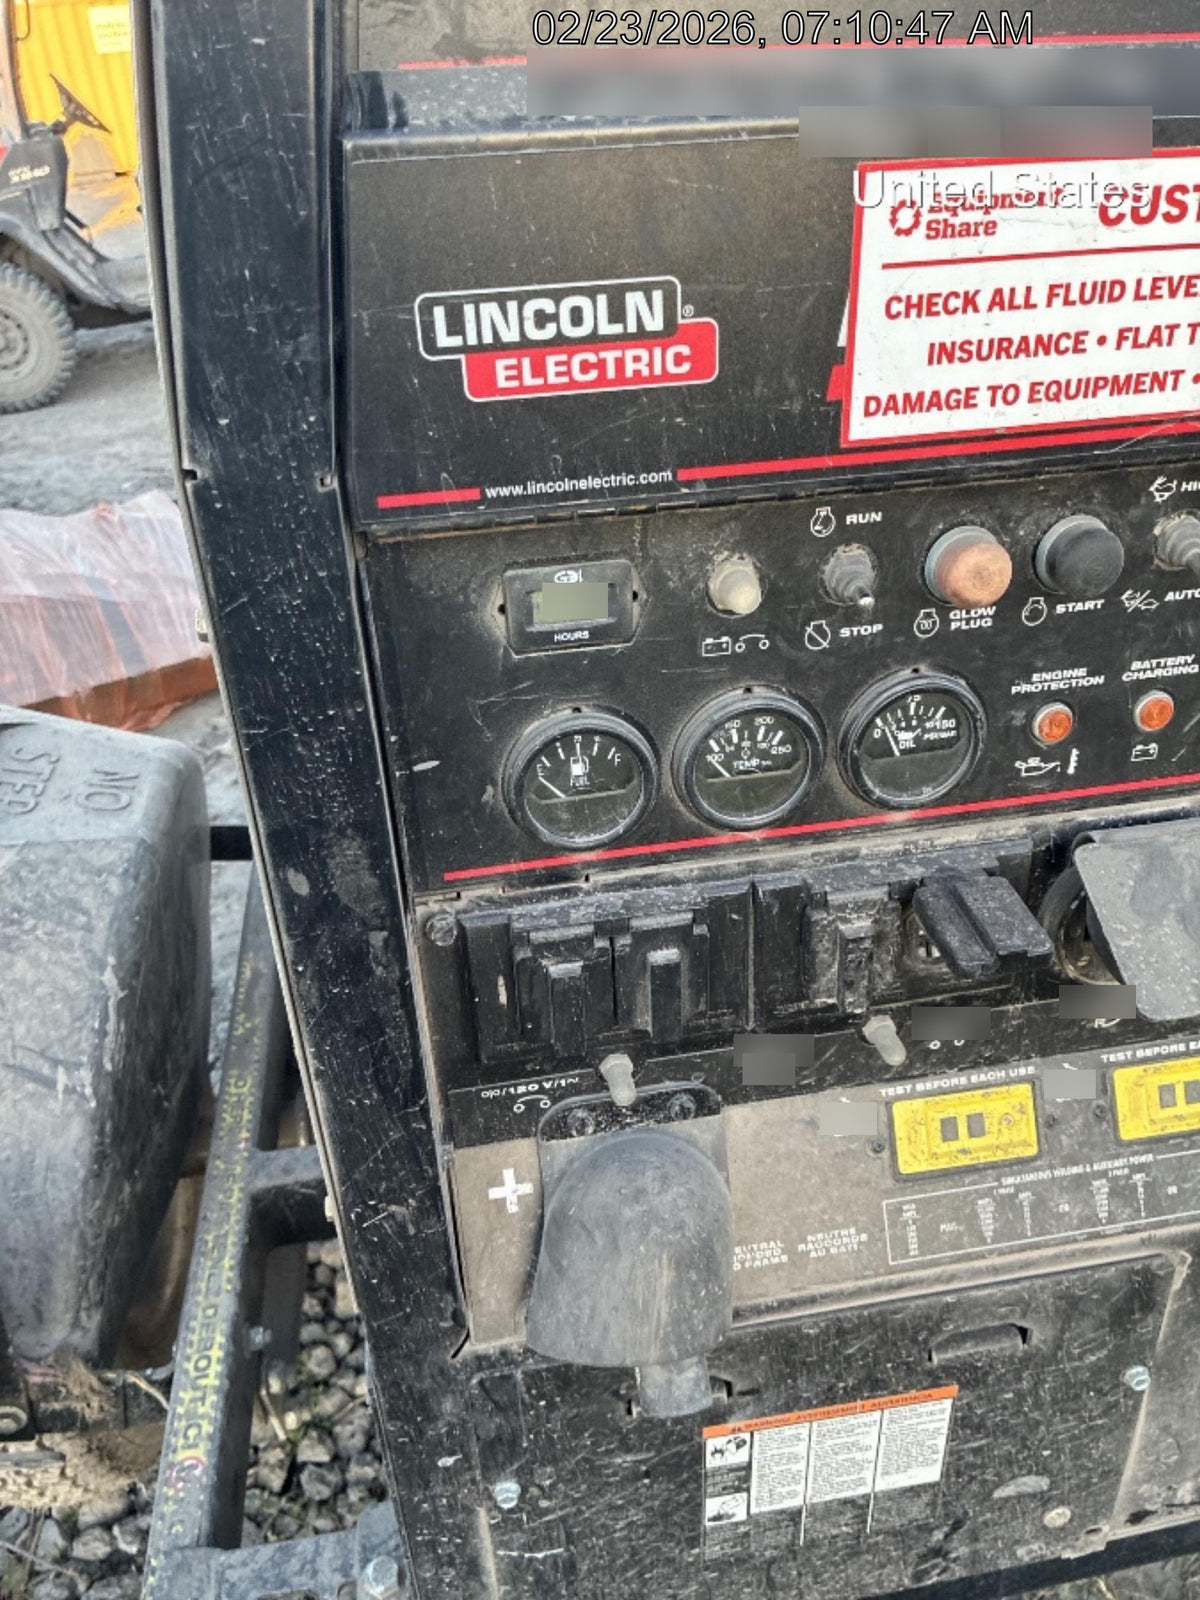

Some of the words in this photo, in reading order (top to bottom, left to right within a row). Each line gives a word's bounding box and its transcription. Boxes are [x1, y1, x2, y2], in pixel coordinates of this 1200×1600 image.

[925, 218, 998, 240] Share
[885, 290, 981, 320] CHECK
[987, 286, 1037, 313] ALL
[1046, 280, 1126, 309] FLUID
[434, 290, 664, 348] LINCOLN
[927, 331, 1088, 366] INSURANCE
[1115, 323, 1181, 350] FLAT
[495, 344, 691, 388] ELECTRIC
[863, 387, 970, 418] DAMAGE
[987, 382, 1020, 407] TO
[1027, 369, 1186, 402] EQUIPMENT
[485, 469, 673, 499] www.lincolnelectric.com
[846, 511, 882, 525] RUN
[949, 606, 996, 620] GLOW
[1055, 599, 1104, 614] START
[839, 623, 883, 637] STOP
[951, 617, 993, 631] PLUG
[554, 630, 589, 642] HOURS
[1131, 654, 1195, 671] BATTERY
[1031, 668, 1088, 682] ENGINE
[1122, 664, 1200, 682] CHARGING
[1011, 675, 1105, 694] PROTECTION
[899, 740, 916, 749] OIL
[614, 753, 621, 767] F
[76, 768, 140, 812] NO
[1100, 1050, 1133, 1063] TEST
[1136, 1043, 1186, 1058] BEFORE
[880, 1084, 912, 1097] TEST
[915, 1076, 968, 1091] BEFORE
[971, 1070, 1006, 1083] EACH
[1009, 1065, 1036, 1076] USE
[734, 1240, 785, 1254] EUTRAL
